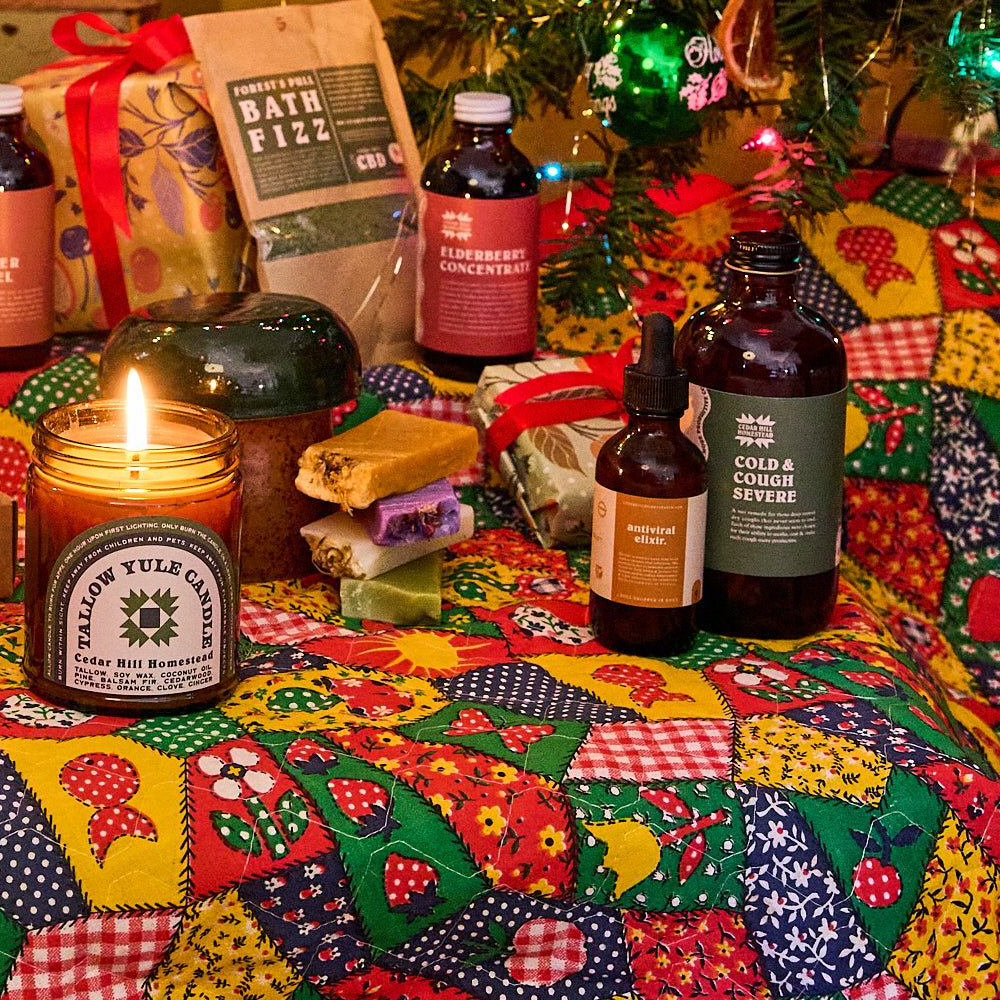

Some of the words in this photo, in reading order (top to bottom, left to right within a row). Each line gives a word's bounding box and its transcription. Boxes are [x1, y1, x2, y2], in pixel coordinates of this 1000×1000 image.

[238, 89, 323, 125] BATH
[247, 117, 331, 153] FIZZ
[356, 151, 387, 170] CBD
[441, 246, 526, 262] ELDERBERRY
[440, 260, 530, 276] CONCENTRATE
[738, 430, 774, 439] HOMESTEAD
[734, 455, 779, 471] COLD
[782, 458, 795, 471] &
[733, 471, 794, 487] COUGH
[732, 487, 797, 503] SEVERE
[627, 523, 676, 535] antiviral
[64, 552, 73, 564] ONE
[73, 540, 87, 554] HOUR
[87, 532, 104, 543] UPON
[104, 526, 124, 536] FIRST
[180, 525, 197, 535] BURN
[197, 531, 207, 540] THE
[634, 535, 667, 545] elixir.
[62, 579, 71, 598] KEEP
[70, 561, 84, 578] AWAY
[84, 548, 102, 563] FROM
[104, 537, 144, 551] CHILDREN
[189, 543, 206, 554] KEEP
[78, 567, 116, 650] TALLOW
[120, 559, 183, 576] YULE
[184, 569, 213, 650] CANDLE
[74, 653, 111, 667] Cedar
[117, 659, 142, 668] Hill
[148, 650, 213, 668] Homestead
[101, 677, 137, 685] BALSAM
[161, 668, 197, 678] COCONUT
[188, 677, 213, 687] GINGER
